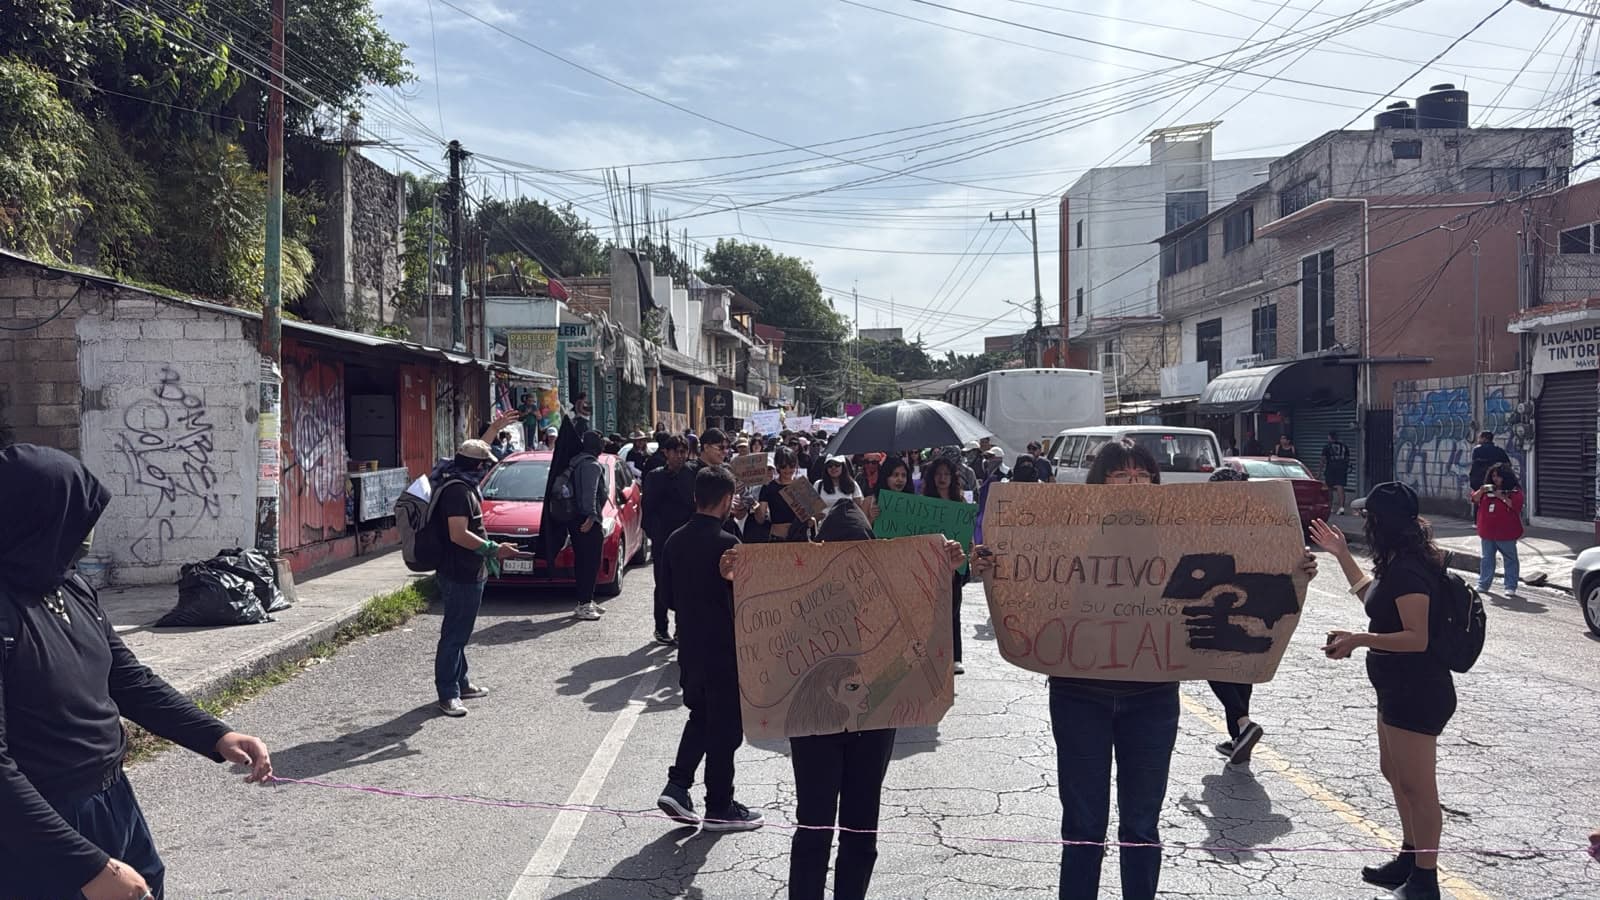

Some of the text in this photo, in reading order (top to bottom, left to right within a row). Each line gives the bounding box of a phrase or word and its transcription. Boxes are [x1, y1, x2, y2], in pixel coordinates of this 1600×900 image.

[882, 495, 949, 523] VENISTE
[1066, 502, 1187, 535] imposible
[993, 554, 1167, 588] EDUCATIVO
[1048, 593, 1070, 612] de
[741, 604, 782, 634] Como
[1002, 614, 1190, 672] SOCIAL
